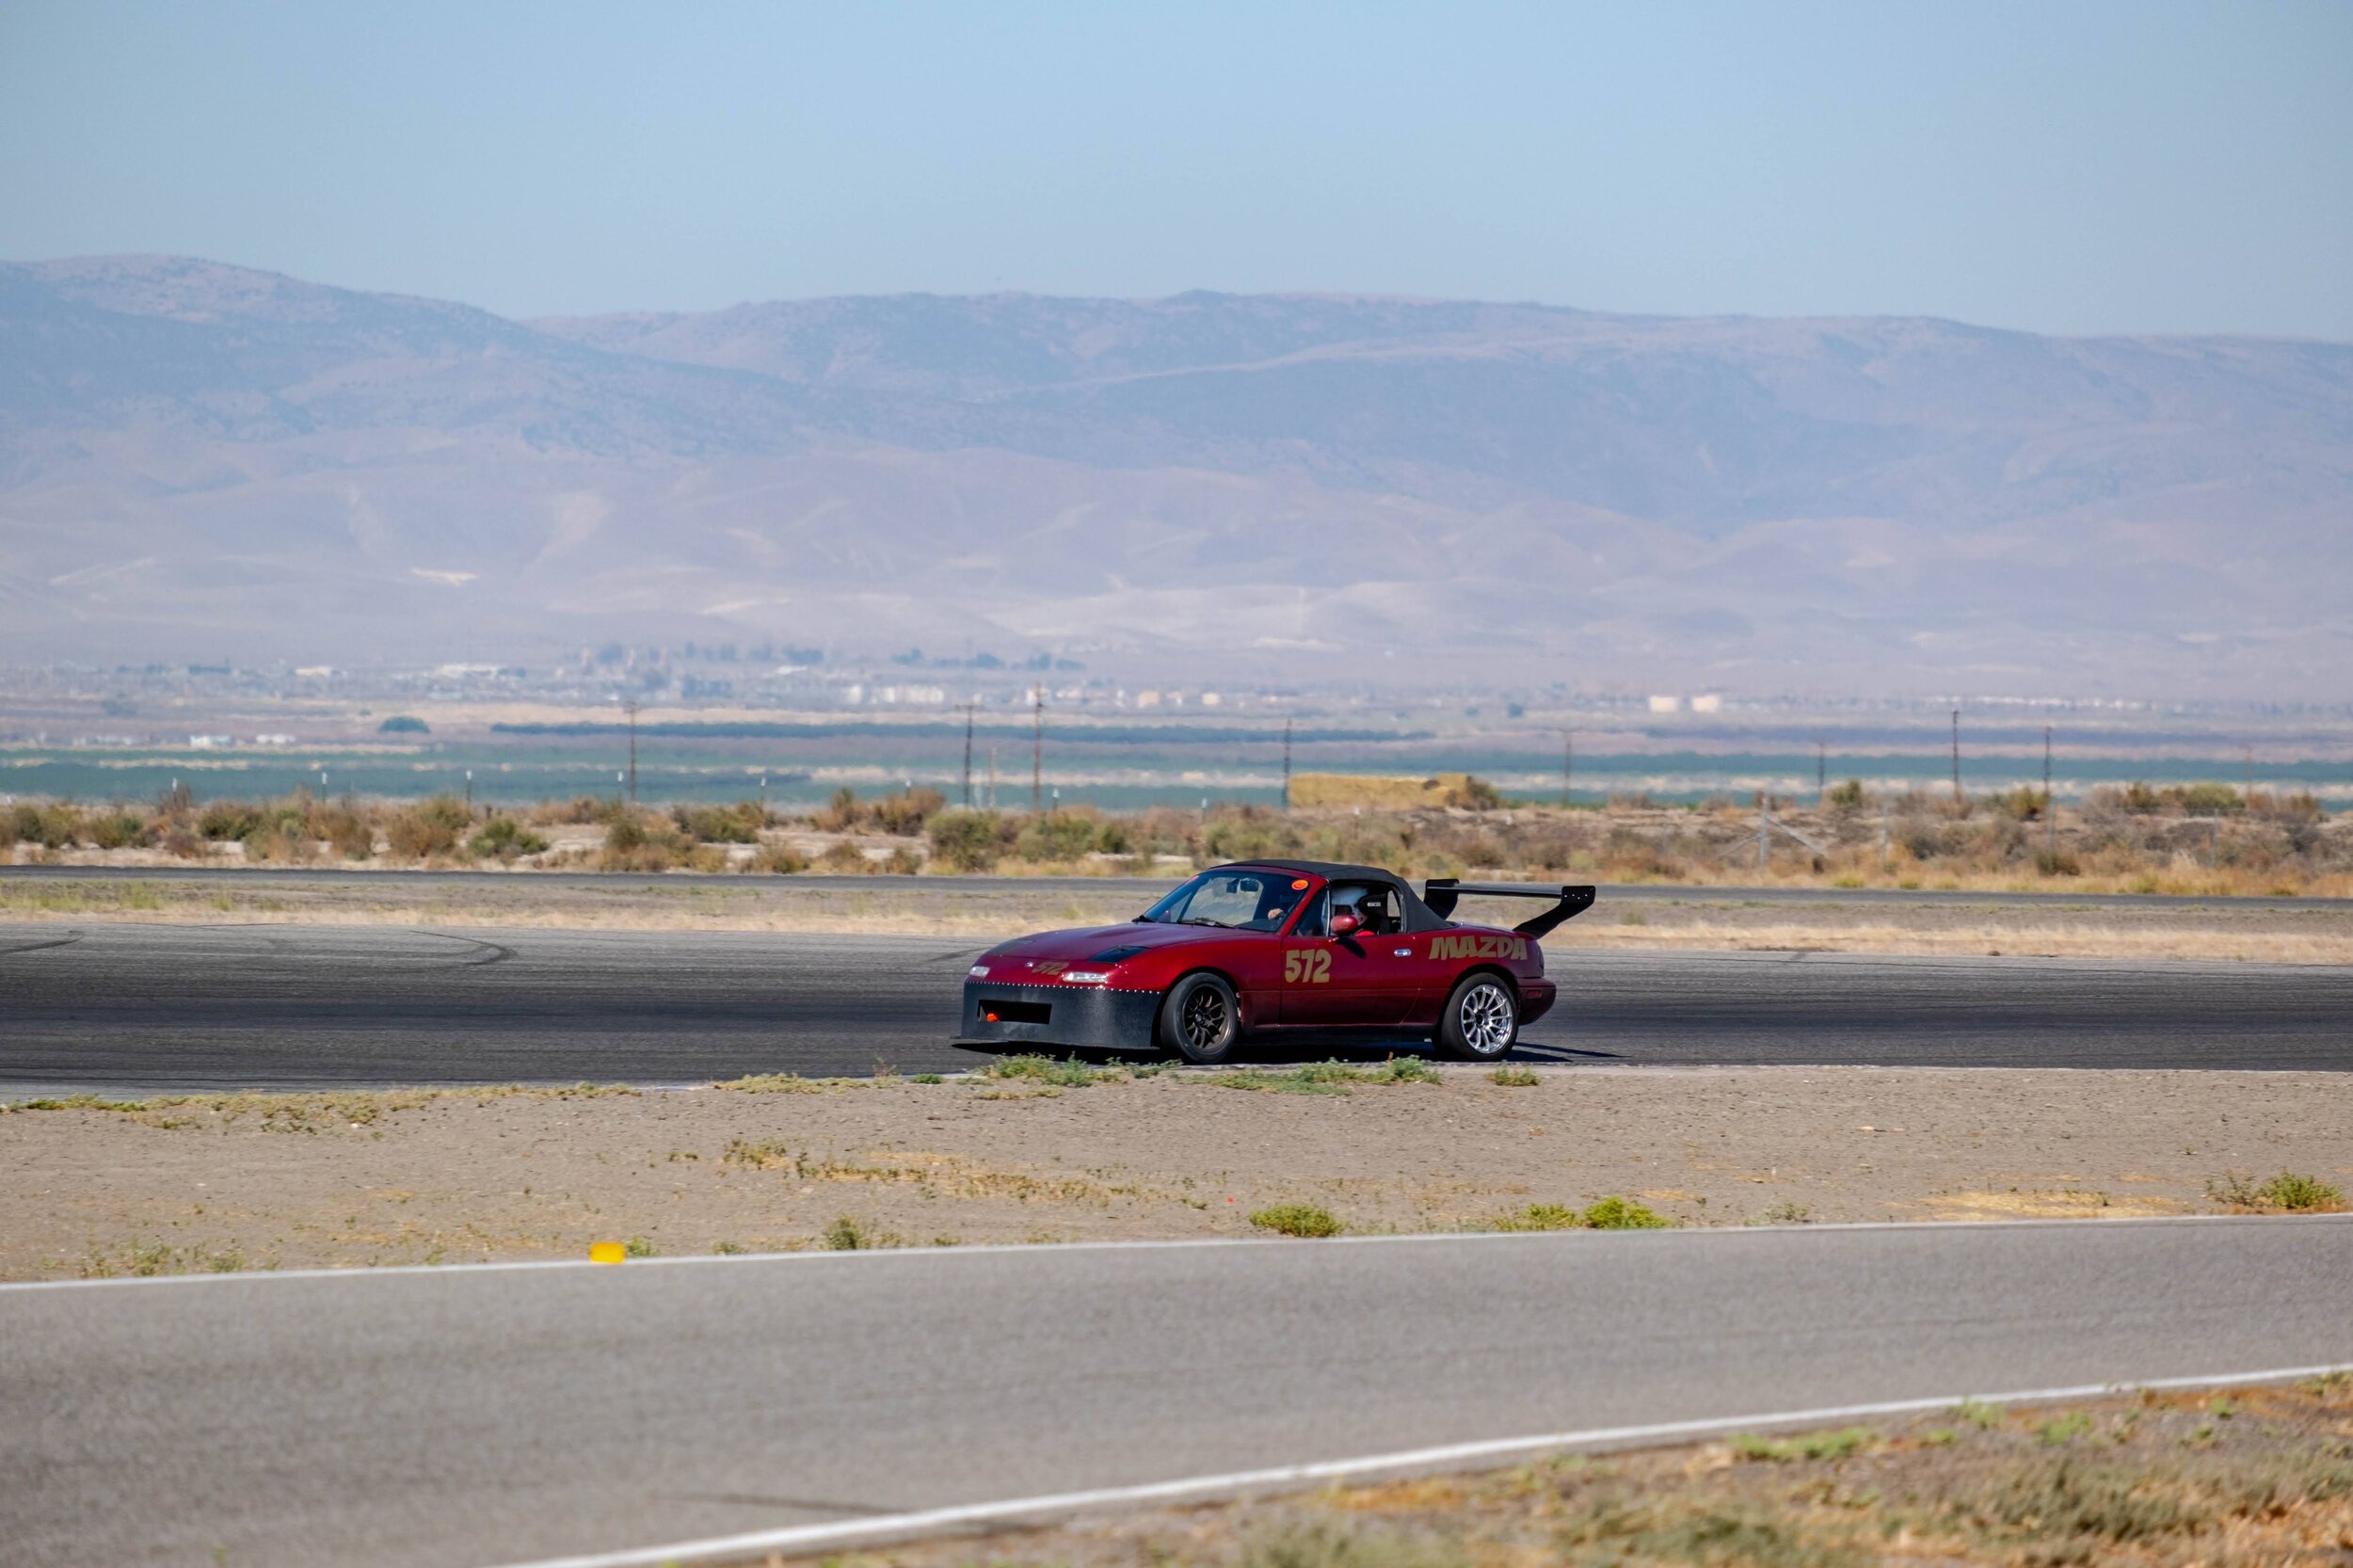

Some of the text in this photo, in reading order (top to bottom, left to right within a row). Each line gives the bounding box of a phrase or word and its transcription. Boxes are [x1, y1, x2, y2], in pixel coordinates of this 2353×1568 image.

[1429, 936, 1528, 960] MAZDA
[1032, 961, 1069, 975] 572
[1285, 949, 1332, 984] 572
